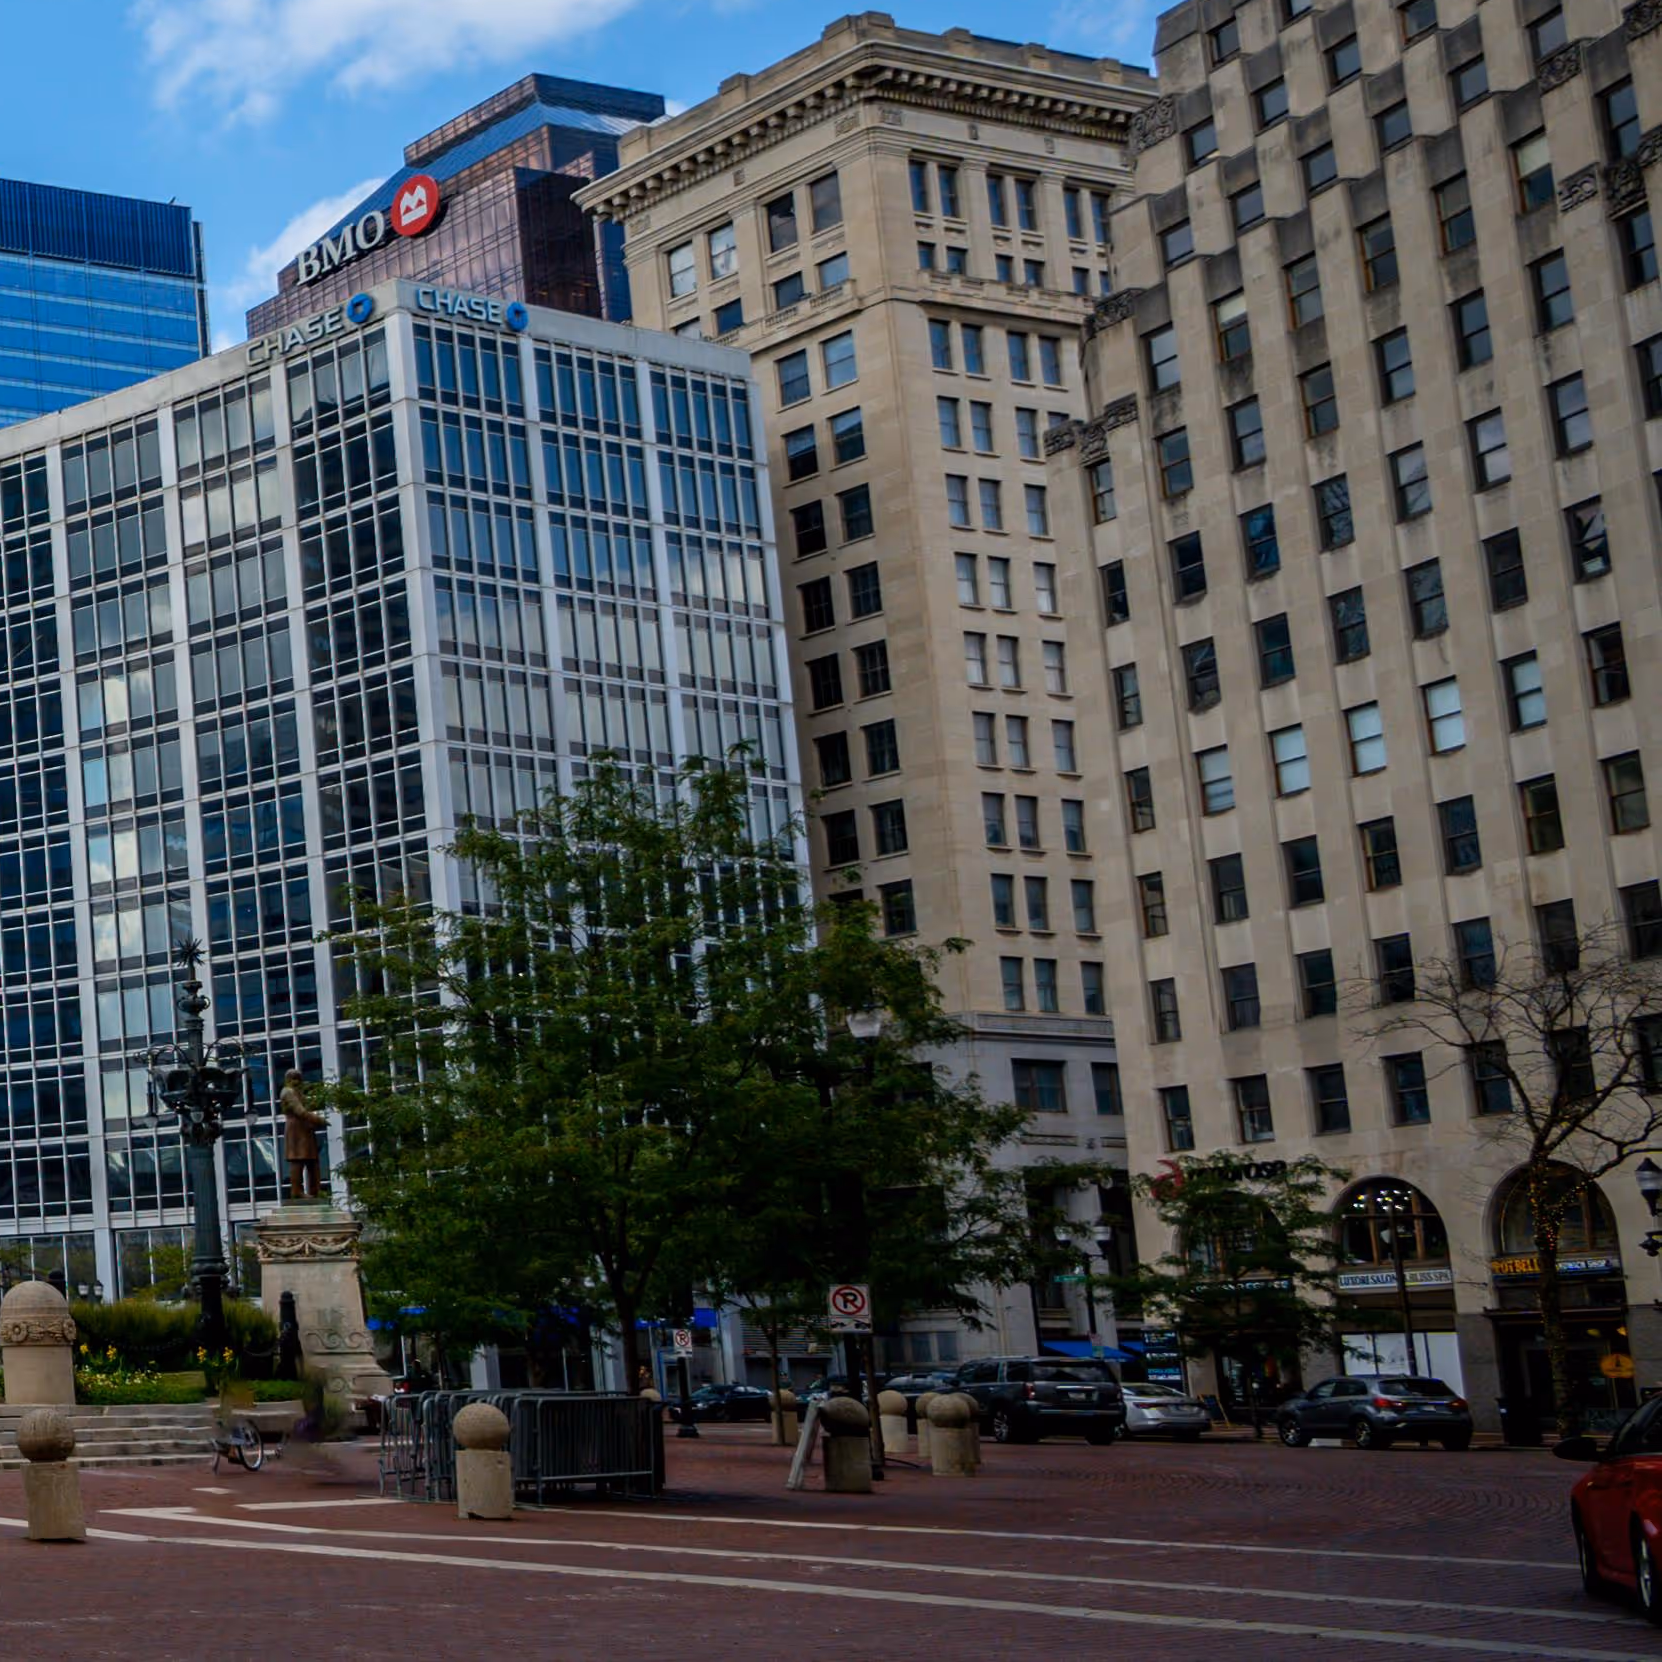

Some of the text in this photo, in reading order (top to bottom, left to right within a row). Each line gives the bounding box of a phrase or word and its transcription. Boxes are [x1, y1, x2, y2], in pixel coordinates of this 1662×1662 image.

[296, 210, 385, 286] BMO
[416, 287, 502, 325] CHASE
[246, 305, 344, 366] CHASE
[1492, 1257, 1541, 1275] POTBELL
